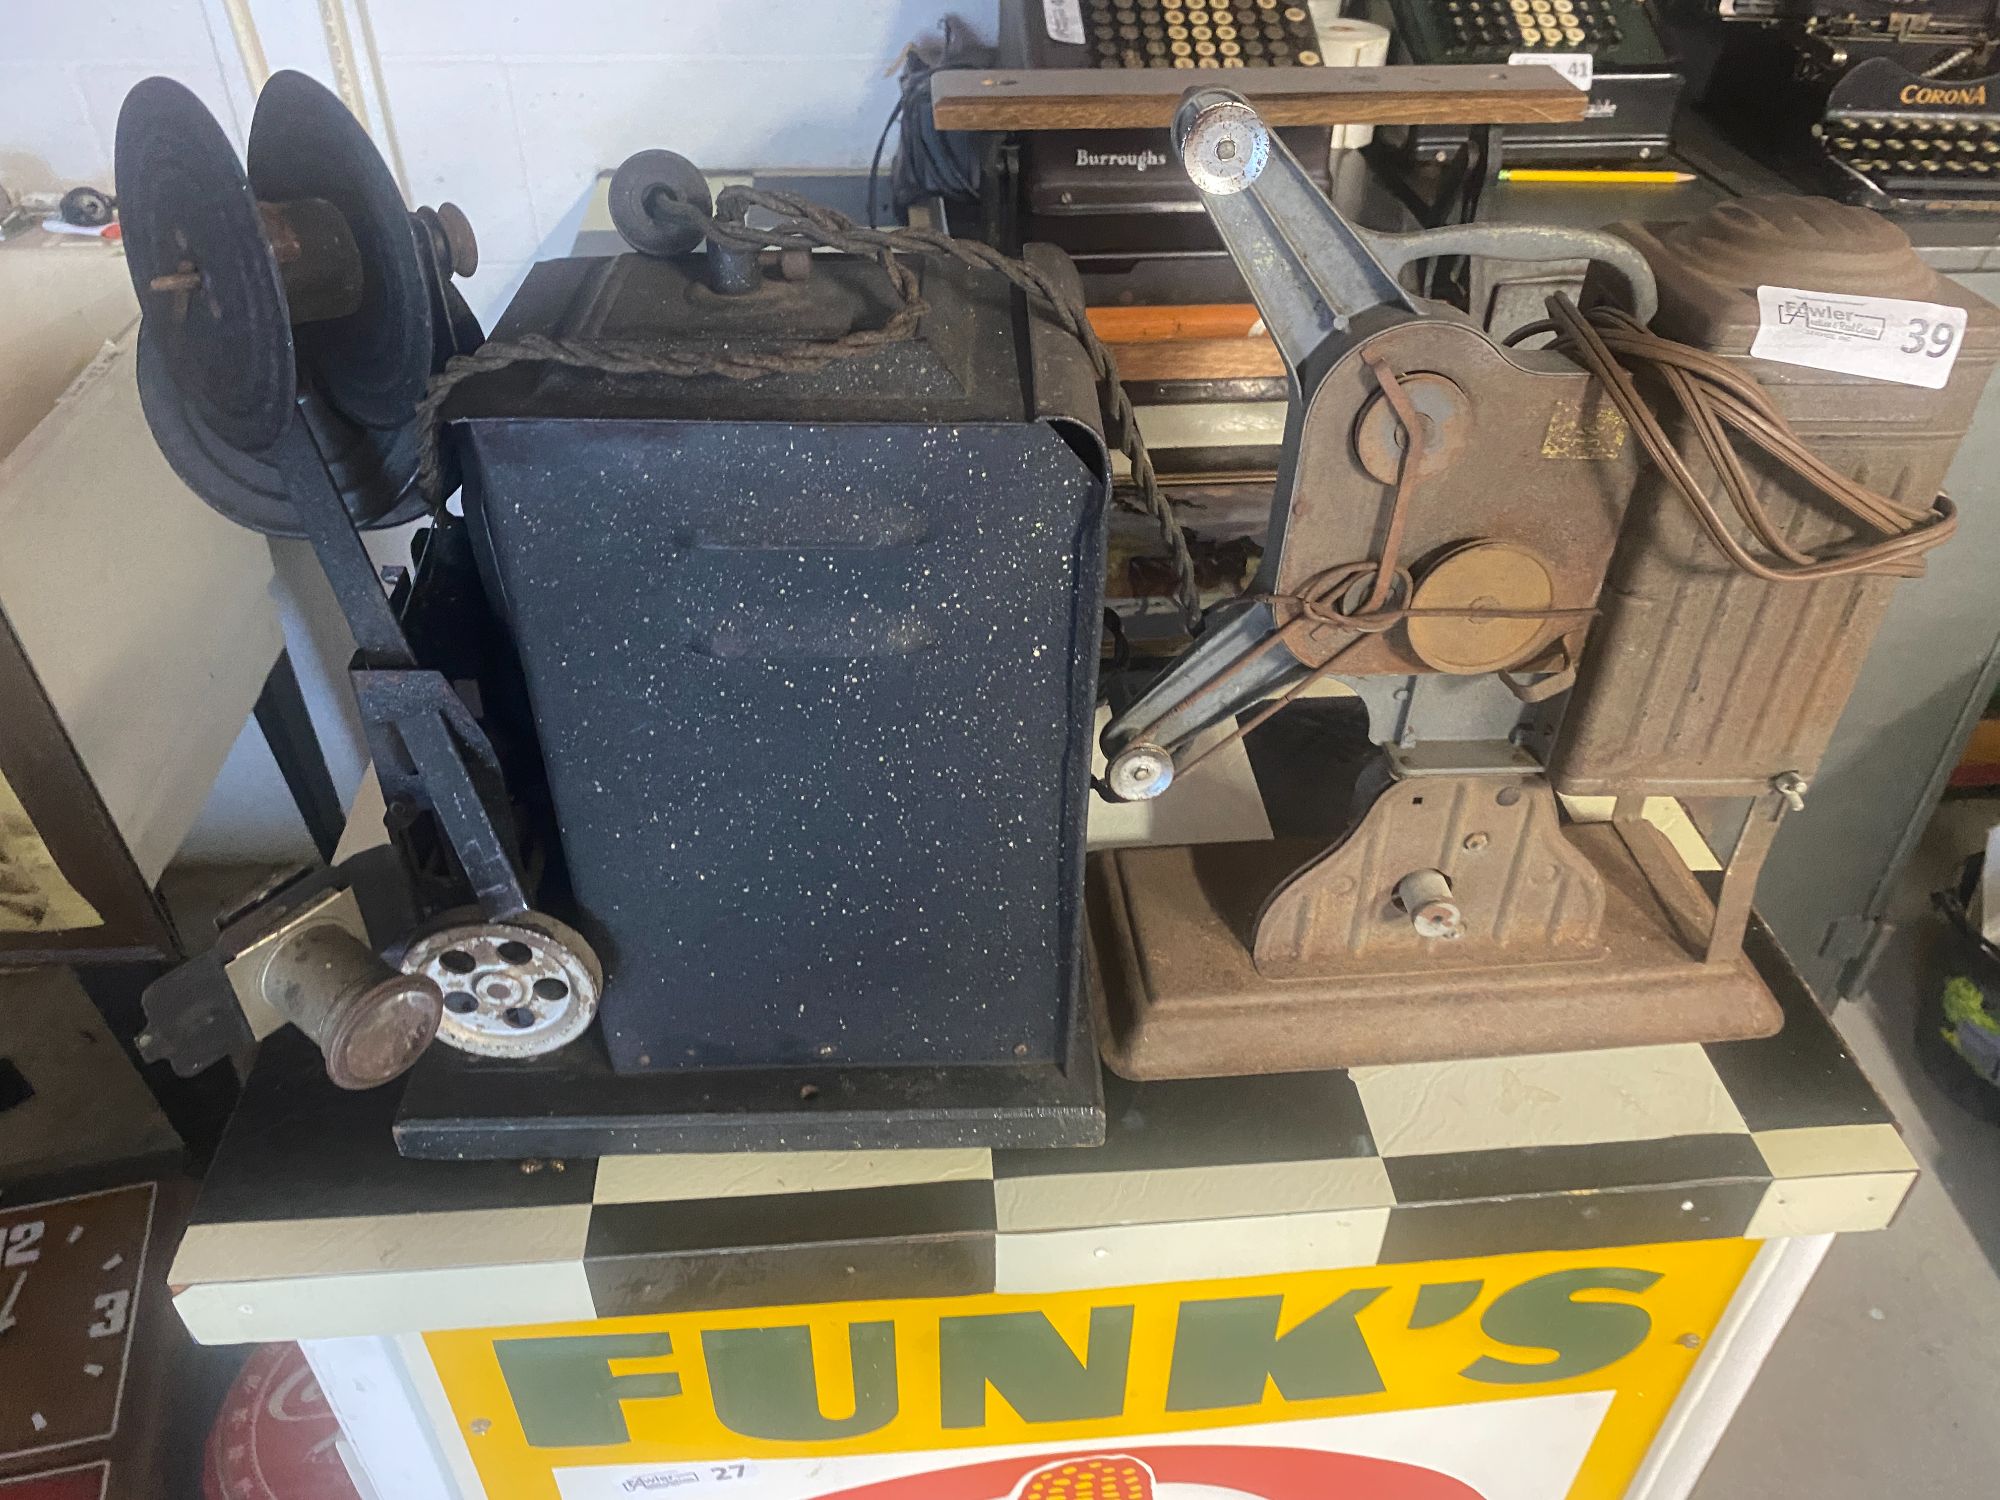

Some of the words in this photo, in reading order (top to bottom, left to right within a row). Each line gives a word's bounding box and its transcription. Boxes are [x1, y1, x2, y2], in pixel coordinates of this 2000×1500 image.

[1567, 62, 1588, 78] 41
[1900, 84, 1986, 105] CORONA
[1076, 149, 1167, 171] Burroughs
[1900, 318, 1954, 358] 39
[89, 1290, 130, 1338] 3
[492, 1267, 1666, 1448] FUNK'S
[711, 1465, 745, 1481] 27
